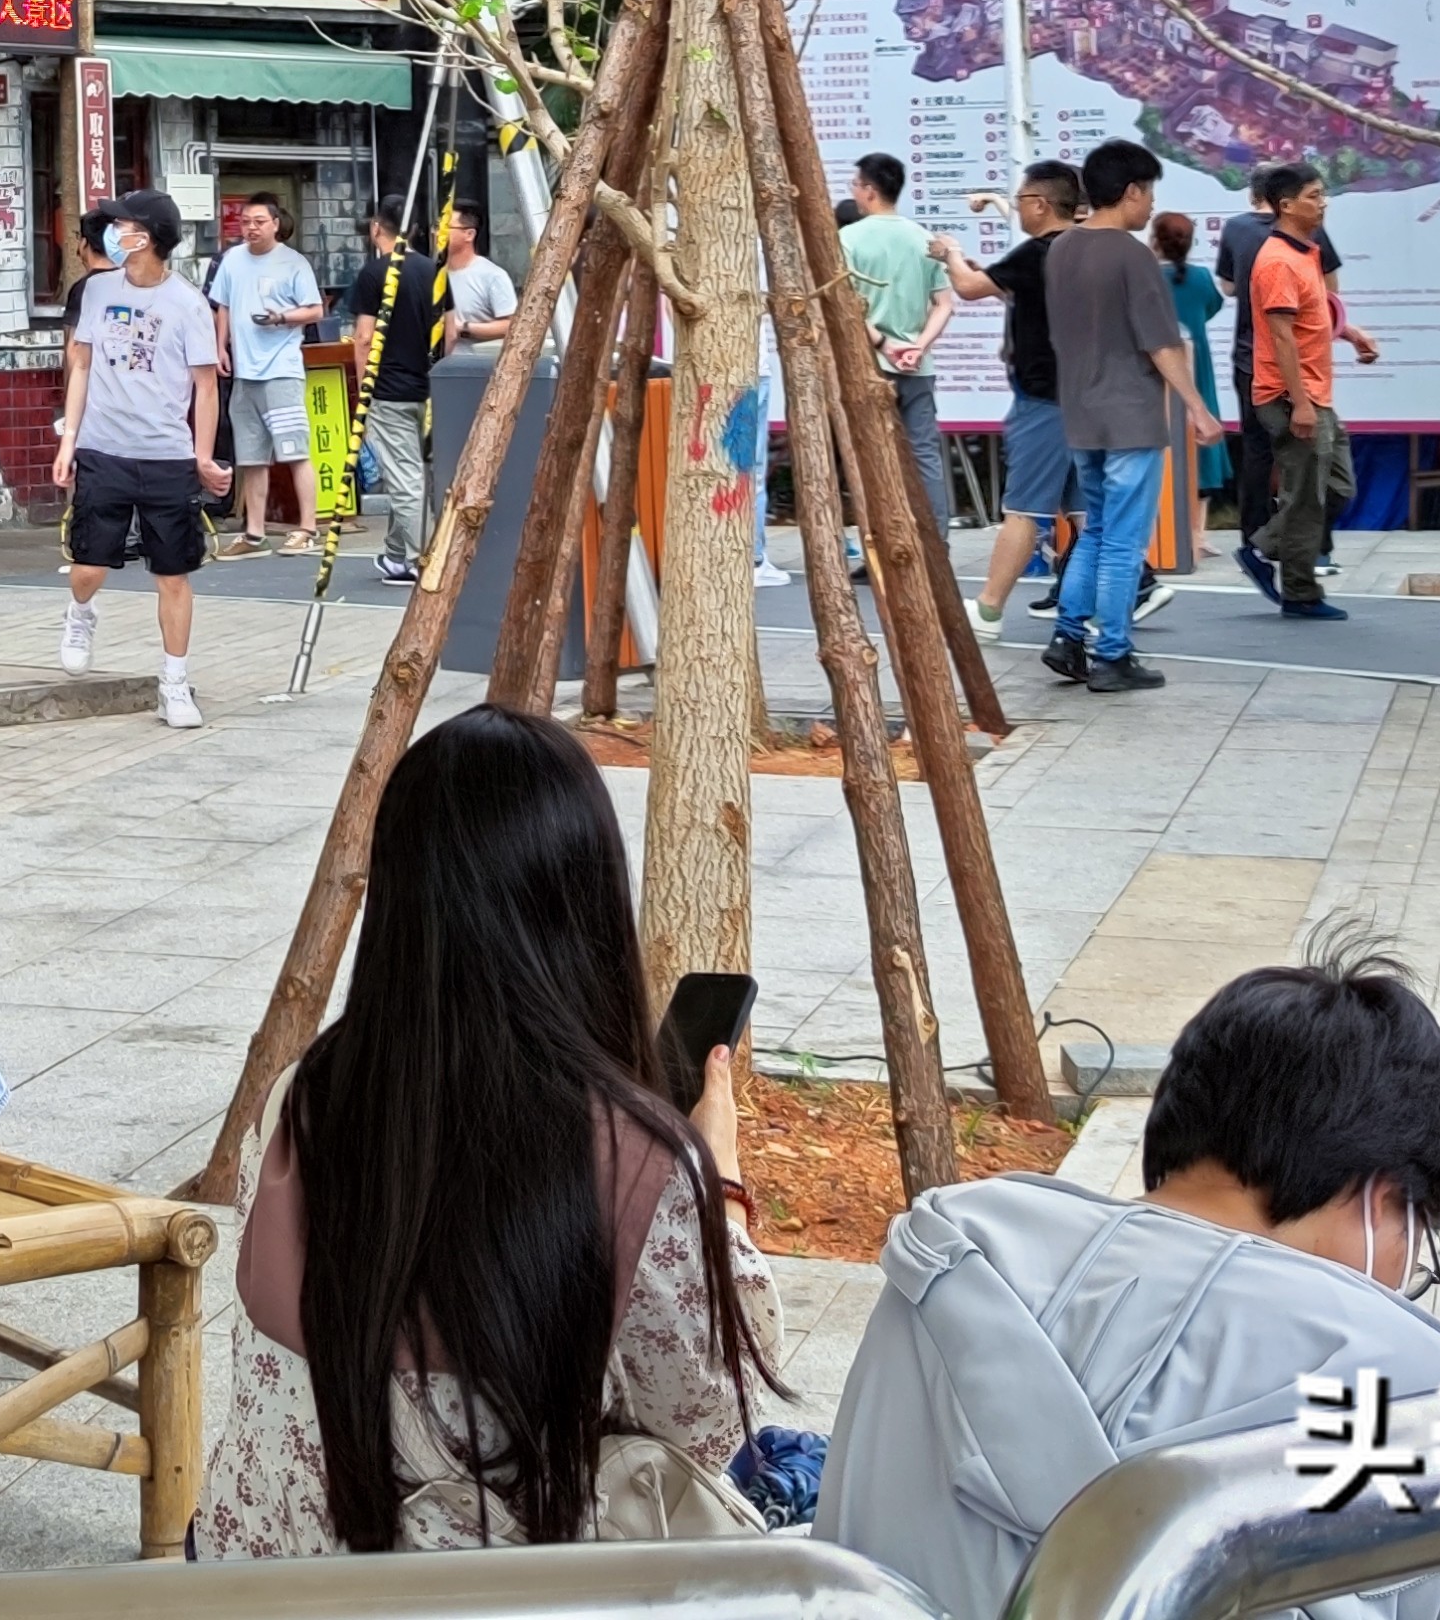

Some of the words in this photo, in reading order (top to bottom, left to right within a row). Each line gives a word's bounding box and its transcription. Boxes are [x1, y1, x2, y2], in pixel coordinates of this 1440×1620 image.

[88, 111, 106, 191] 取号处
[311, 385, 334, 492] 排位台
